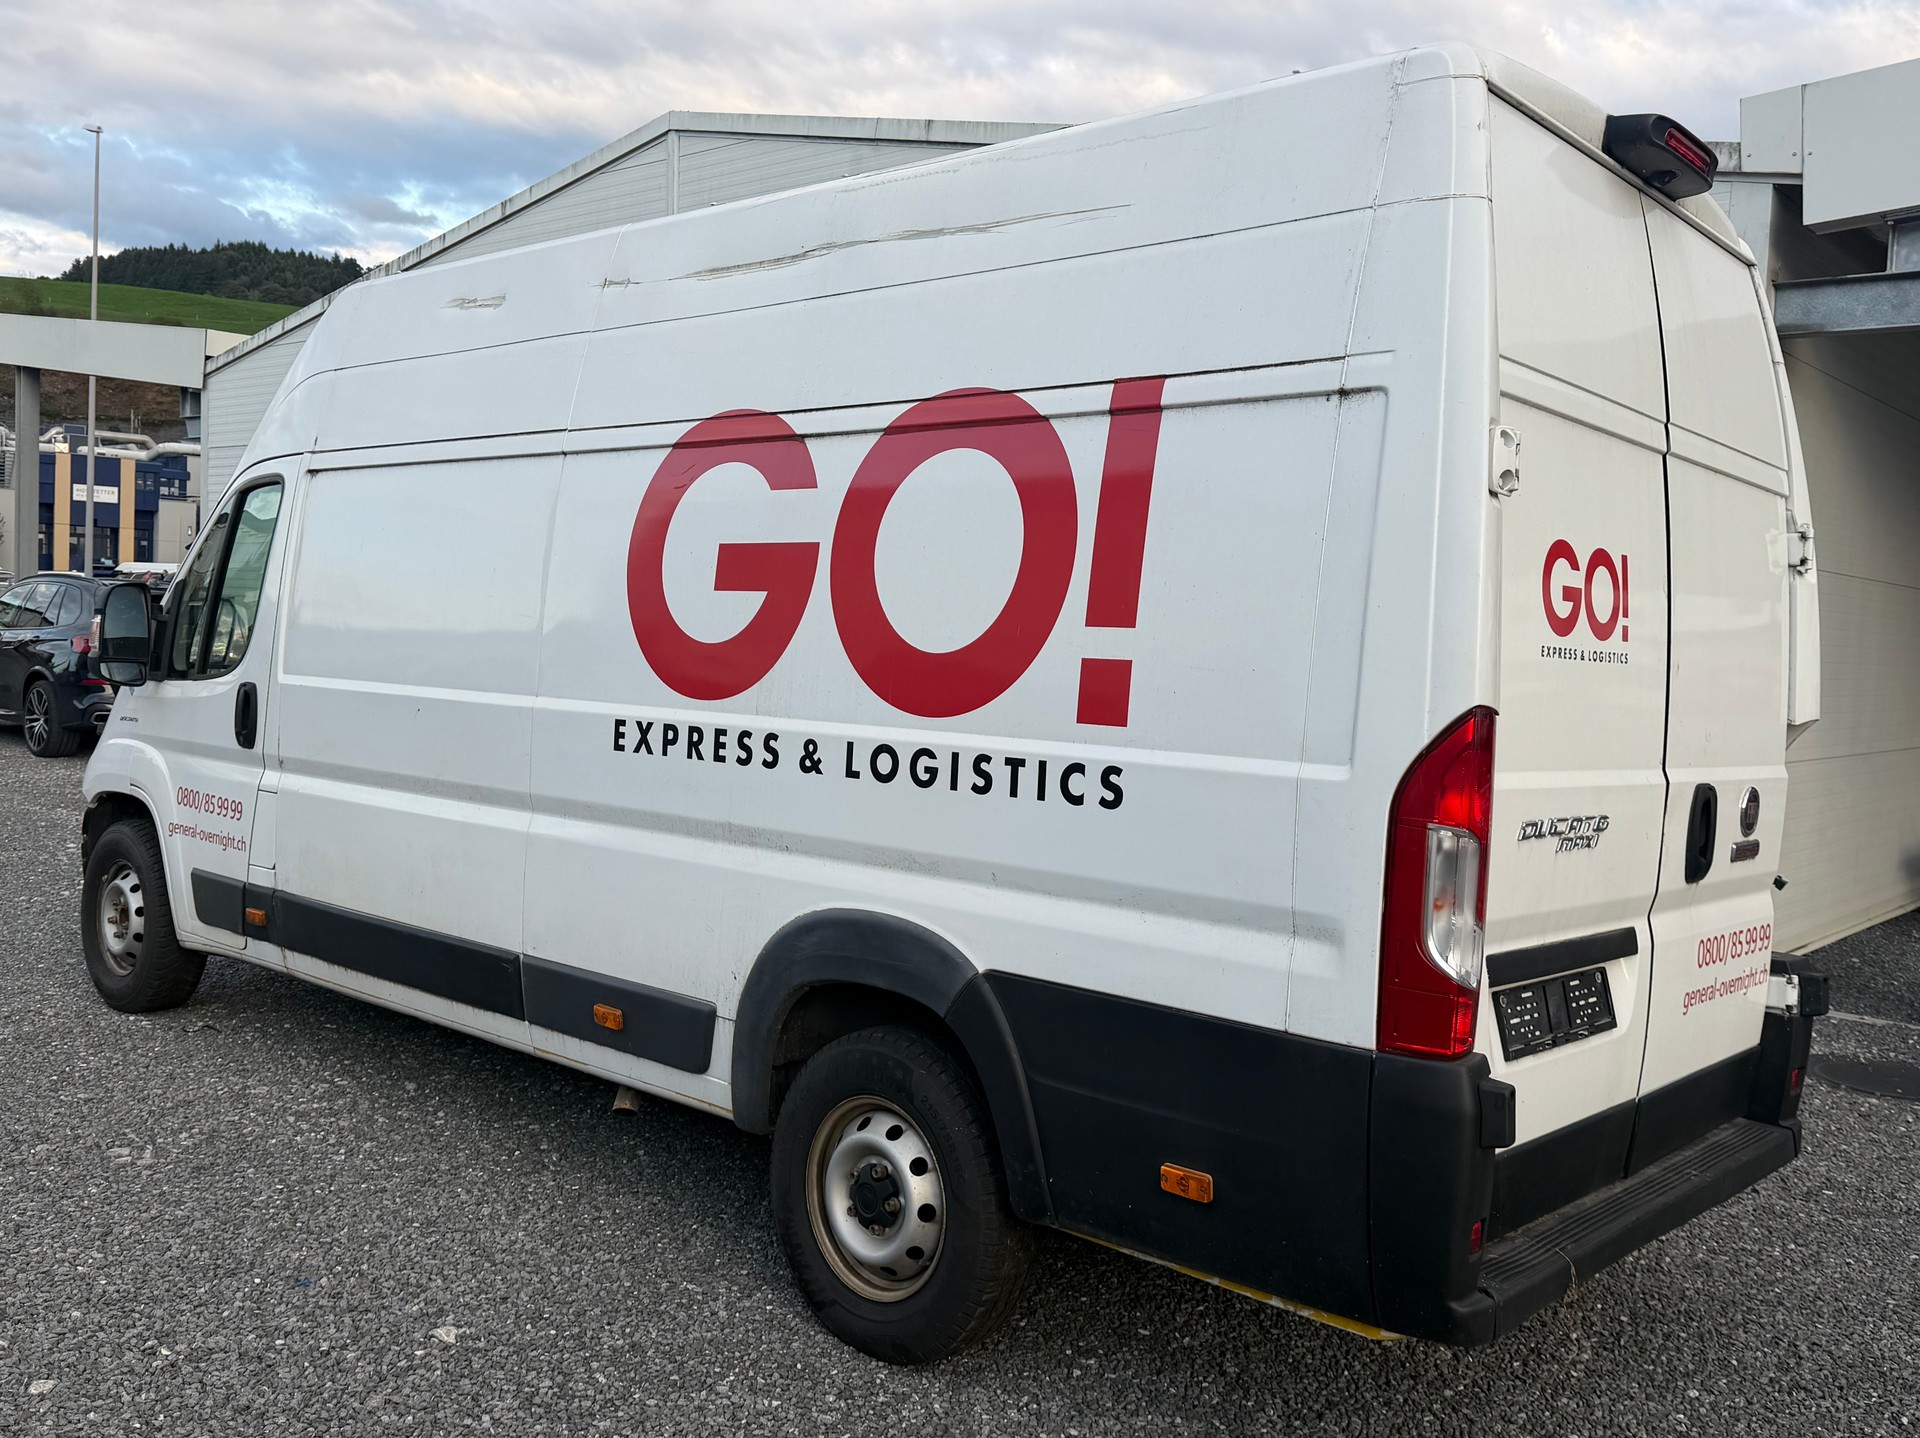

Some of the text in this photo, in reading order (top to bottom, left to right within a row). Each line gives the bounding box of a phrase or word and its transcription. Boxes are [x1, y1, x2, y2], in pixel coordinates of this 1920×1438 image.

[627, 377, 1166, 728] GO!
[1541, 538, 1629, 643] GO!
[1540, 645, 1629, 664] EXPRESS & LOGISTICS
[613, 718, 1125, 811] EXPRESS & LOGISTICS
[176, 786, 216, 814] 0800/85
[168, 822, 247, 853] general-overnight.ch
[1518, 815, 1609, 841] DUCATO
[1555, 834, 1600, 853] MAXI
[1697, 930, 1744, 968] 0800/85
[1682, 962, 1768, 1016] general-overnight.ch
